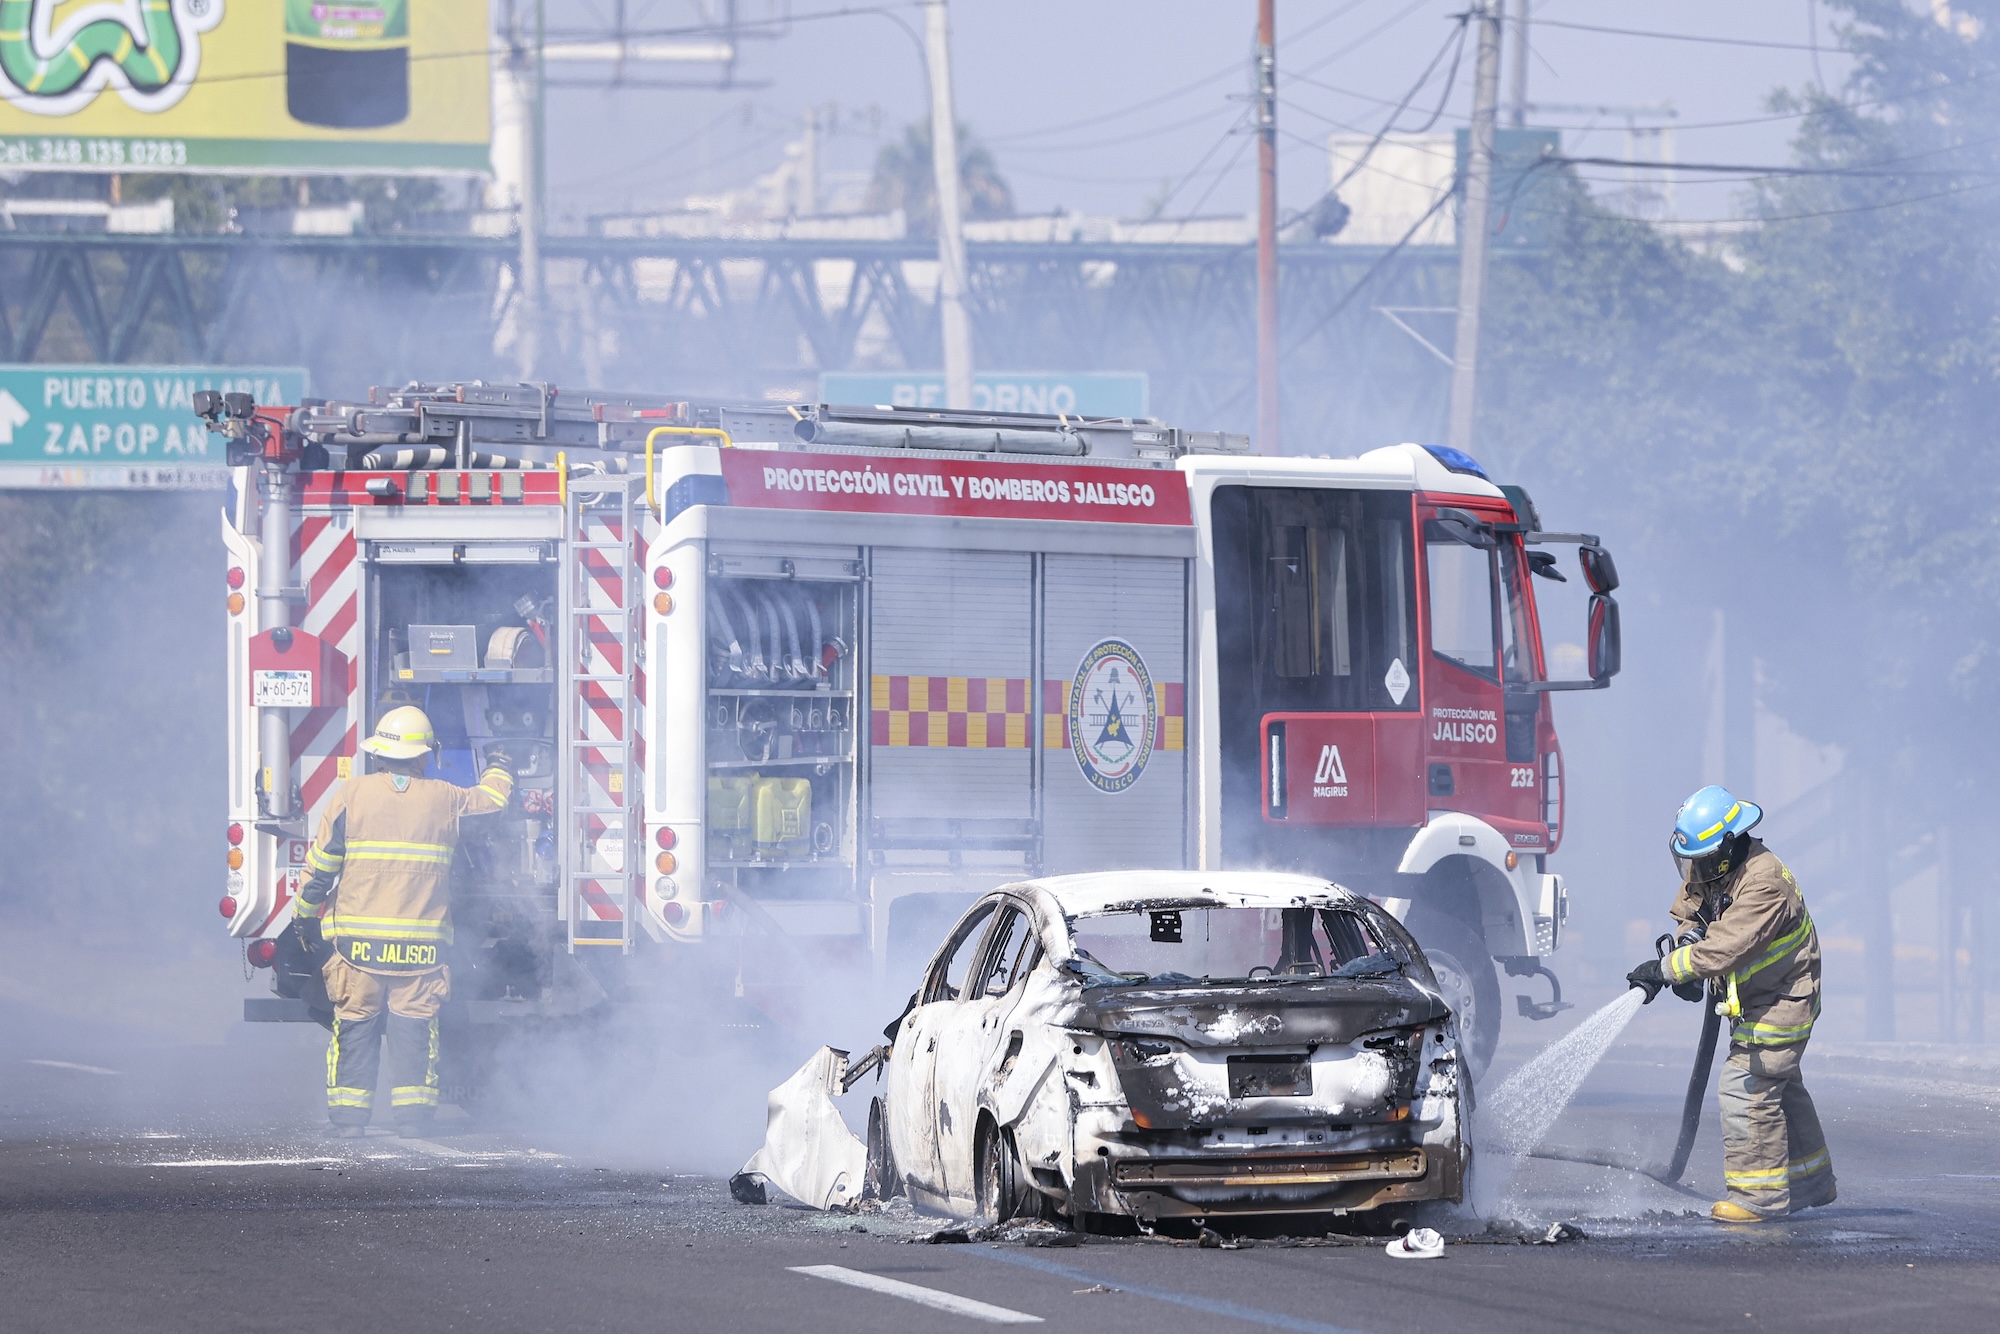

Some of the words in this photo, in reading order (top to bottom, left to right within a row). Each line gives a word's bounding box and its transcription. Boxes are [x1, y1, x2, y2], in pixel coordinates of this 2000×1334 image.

[45, 377, 146, 409] PUERTO
[893, 384, 1076, 415] REORNO
[44, 423, 208, 454] ZAPOPAN
[763, 465, 890, 495] PROTECCIÓN
[894, 473, 949, 498] CIVIL
[952, 476, 965, 498] Y
[969, 476, 1069, 503] BOMBEROS
[1074, 481, 1155, 507] JALISCO
[1084, 655, 1095, 670] DE
[1093, 643, 1138, 666] PROTECCIÓN
[1136, 662, 1150, 691] CIVIL
[1071, 670, 1087, 718] ESTATAL
[1433, 707, 1478, 720] PROTECCIÓN
[1479, 710, 1497, 721] CIVIL
[1072, 720, 1087, 767] UNIDAD
[1137, 702, 1154, 769] BOMBEROS
[1433, 722, 1497, 743] JALISCO
[1091, 773, 1134, 790] JALISCO
[1511, 768, 1534, 787] 232
[1313, 786, 1348, 797] MAGIRUS
[351, 941, 371, 962] PC
[376, 943, 436, 965] JALISCO
[1113, 1018, 1165, 1029] VERSA
